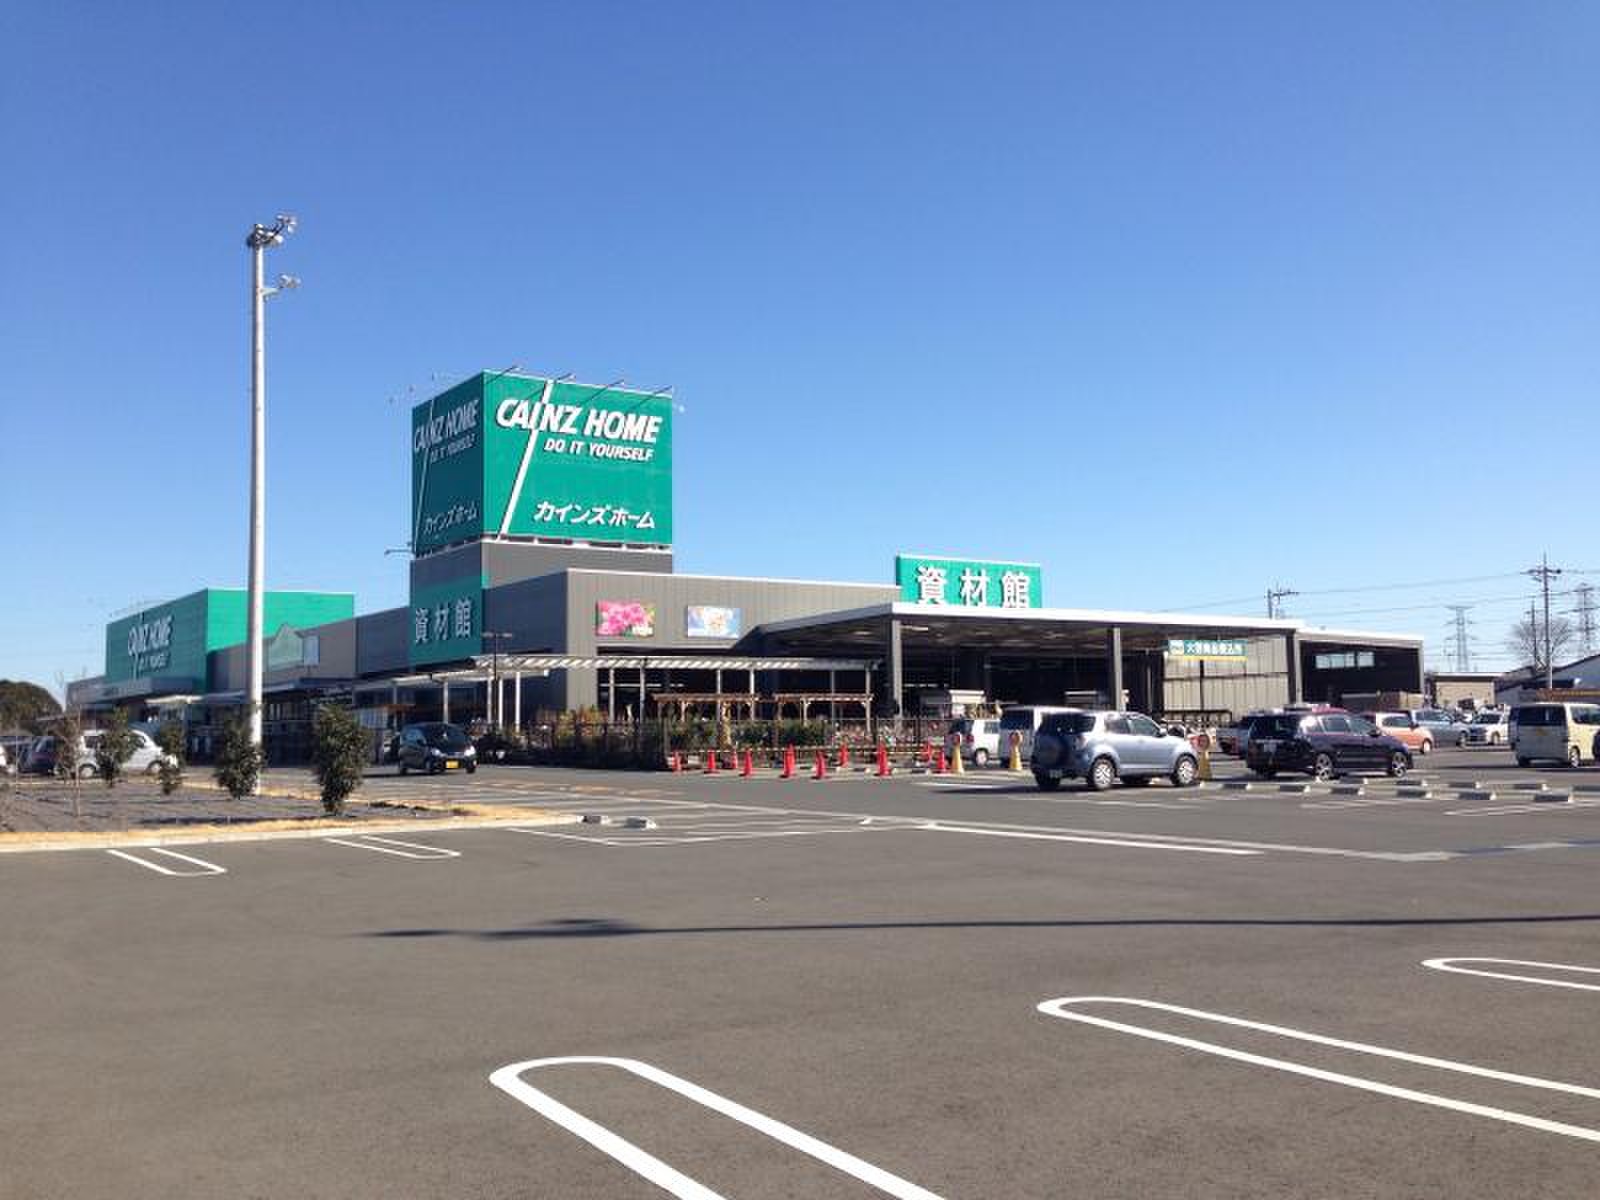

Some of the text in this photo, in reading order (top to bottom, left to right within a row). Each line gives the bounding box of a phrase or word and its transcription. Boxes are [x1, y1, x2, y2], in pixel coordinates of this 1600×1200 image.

[496, 399, 663, 443] CAINZ HOME
[544, 438, 654, 462] DO IT YOURSELF
[534, 500, 656, 529] カインズホーム
[916, 565, 1031, 609] 資材館
[415, 598, 472, 644] 資材館
